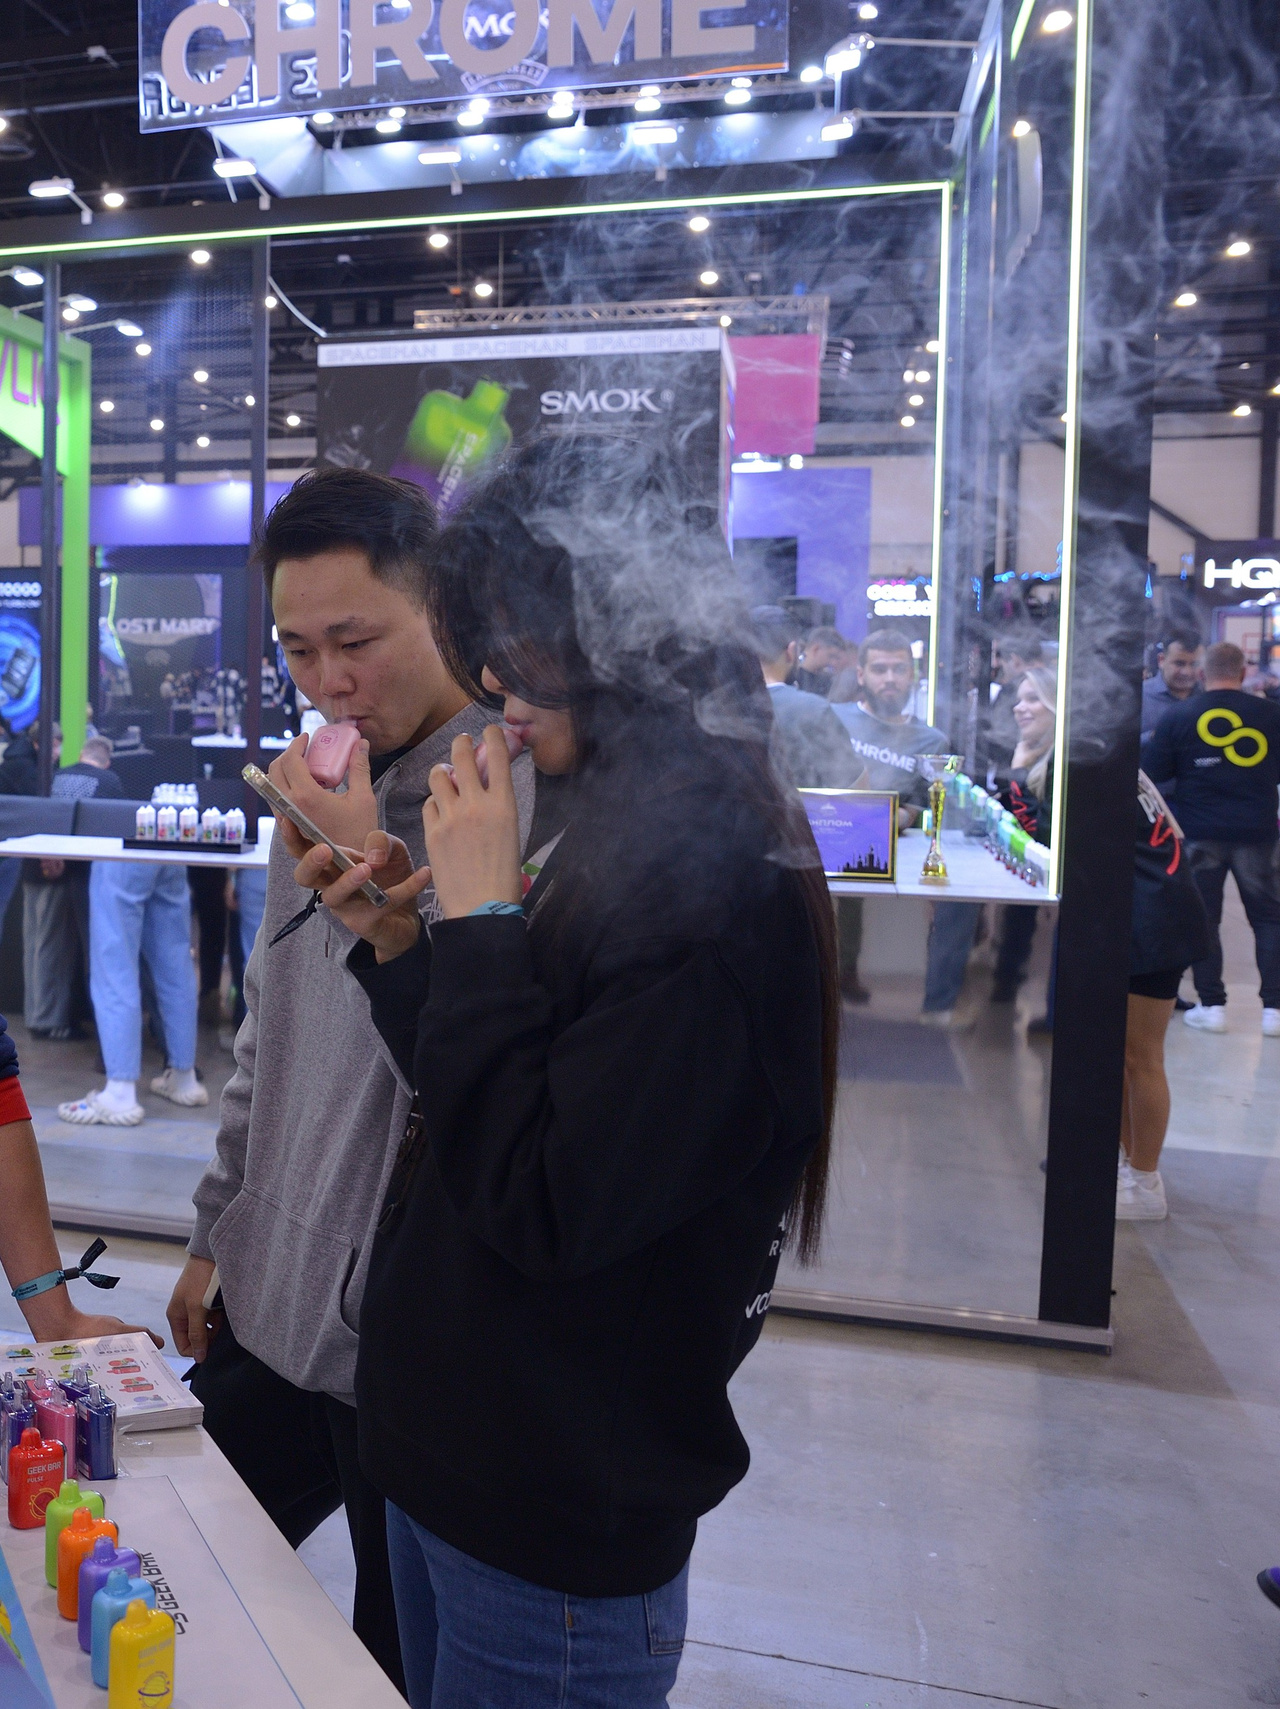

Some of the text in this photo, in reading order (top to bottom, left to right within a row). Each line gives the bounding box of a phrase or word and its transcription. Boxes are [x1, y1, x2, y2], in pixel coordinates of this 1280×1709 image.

[161, 0, 755, 105] CHROME
[325, 332, 706, 363] SPACEMAN SPACEMAN SPACEMAN
[1204, 558, 1280, 589] HQ
[116, 617, 158, 635] OST
[26, 1476, 44, 1484] PULSE
[27, 1461, 62, 1475] GEEK BAR
